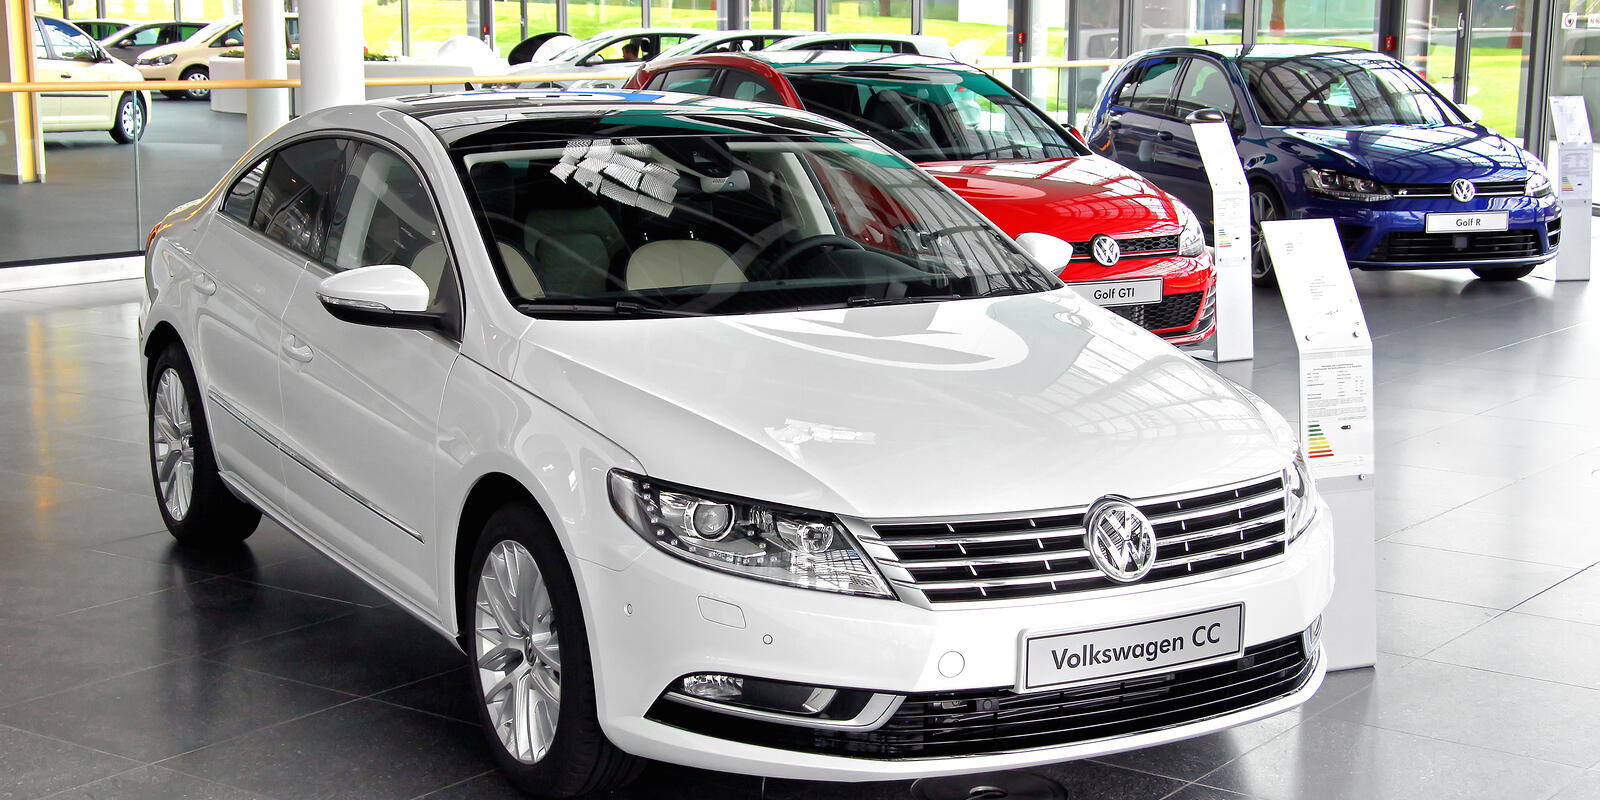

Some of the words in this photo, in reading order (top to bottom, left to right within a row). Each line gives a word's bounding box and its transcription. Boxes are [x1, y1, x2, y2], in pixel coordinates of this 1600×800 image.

[1456, 218, 1474, 227] Golf
[1475, 218, 1481, 226] R
[1093, 288, 1116, 299] Golf
[1118, 287, 1135, 298] GTI
[1093, 502, 1154, 578] VW
[1051, 635, 1184, 670] Volkswagen
[1191, 622, 1221, 647] CC
